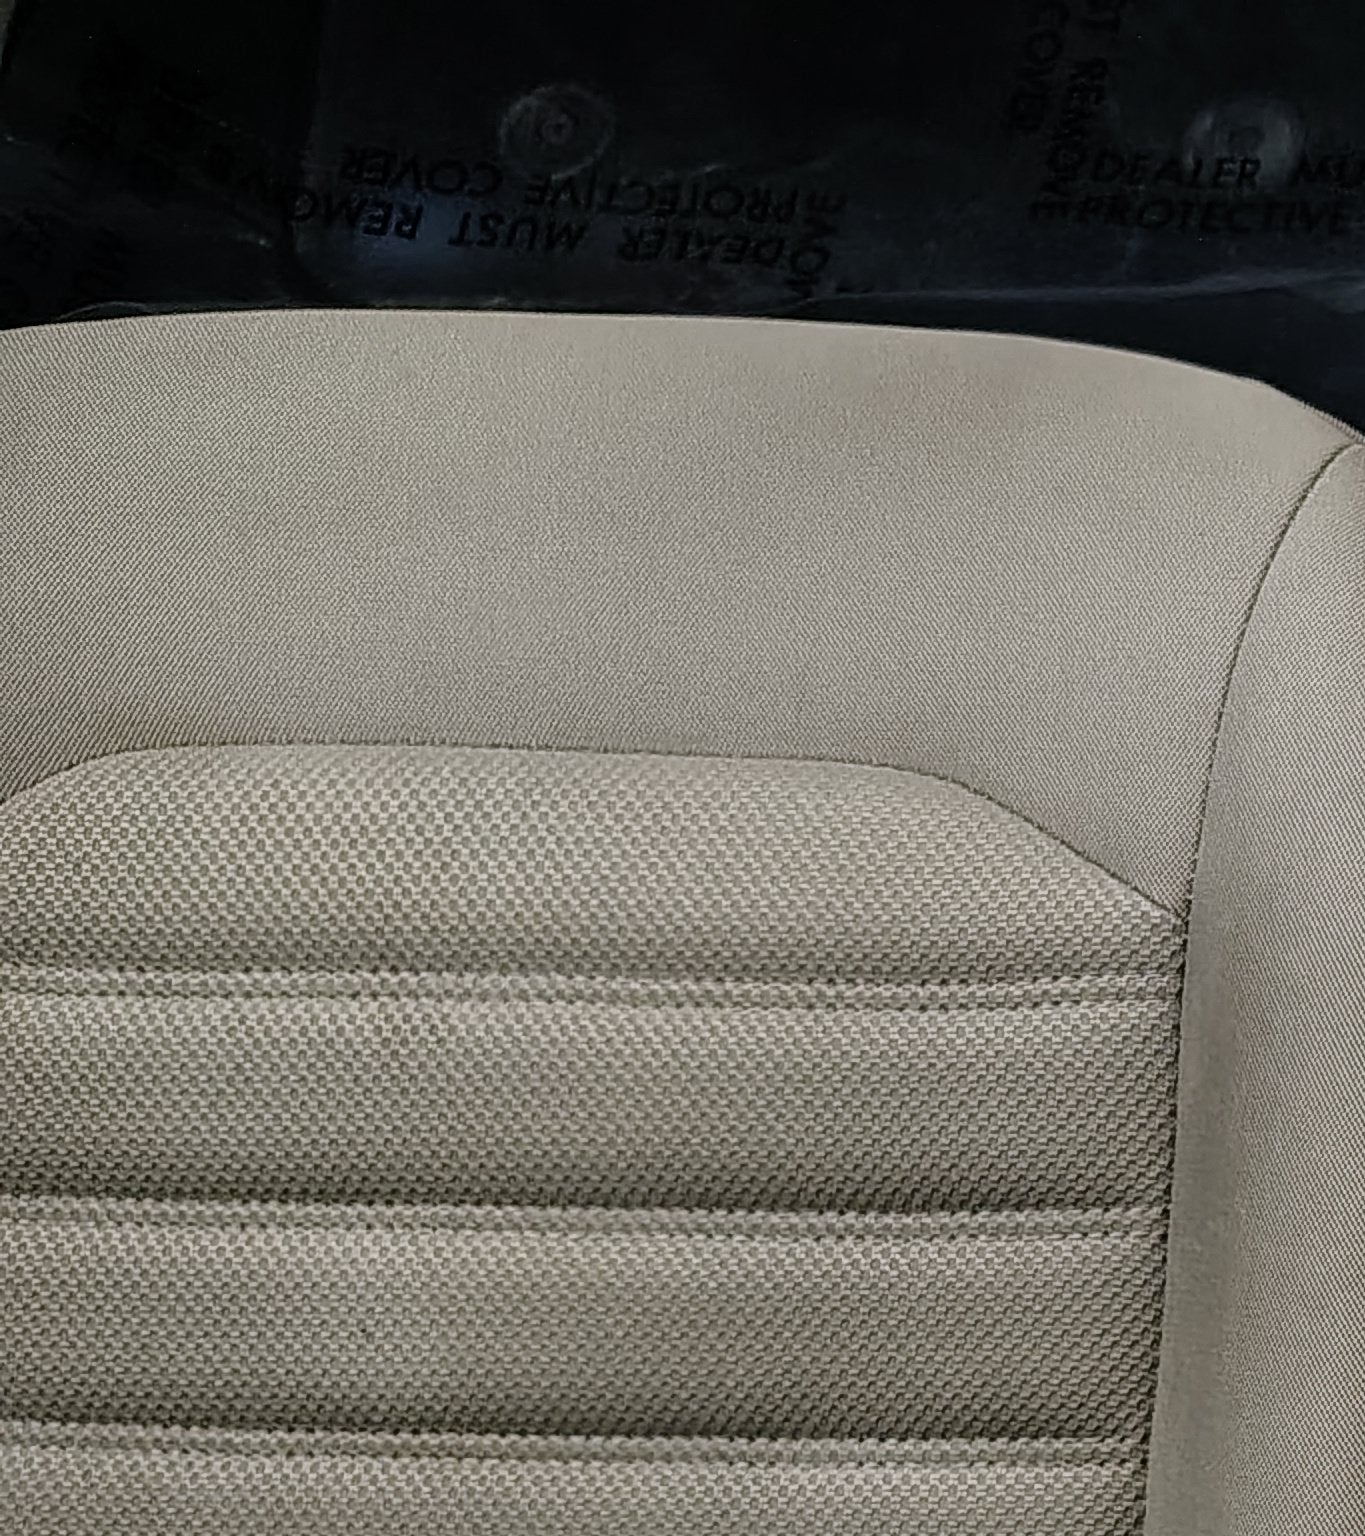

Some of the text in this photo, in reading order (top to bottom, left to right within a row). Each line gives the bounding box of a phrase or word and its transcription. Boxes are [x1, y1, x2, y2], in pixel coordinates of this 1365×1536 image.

[340, 149, 798, 225] PROTECTIVE COVER
[1091, 149, 1262, 189] DEALER
[449, 209, 588, 256] MUST
[1077, 195, 1353, 236] PROTECTIVE
[616, 222, 786, 269] DEALER
